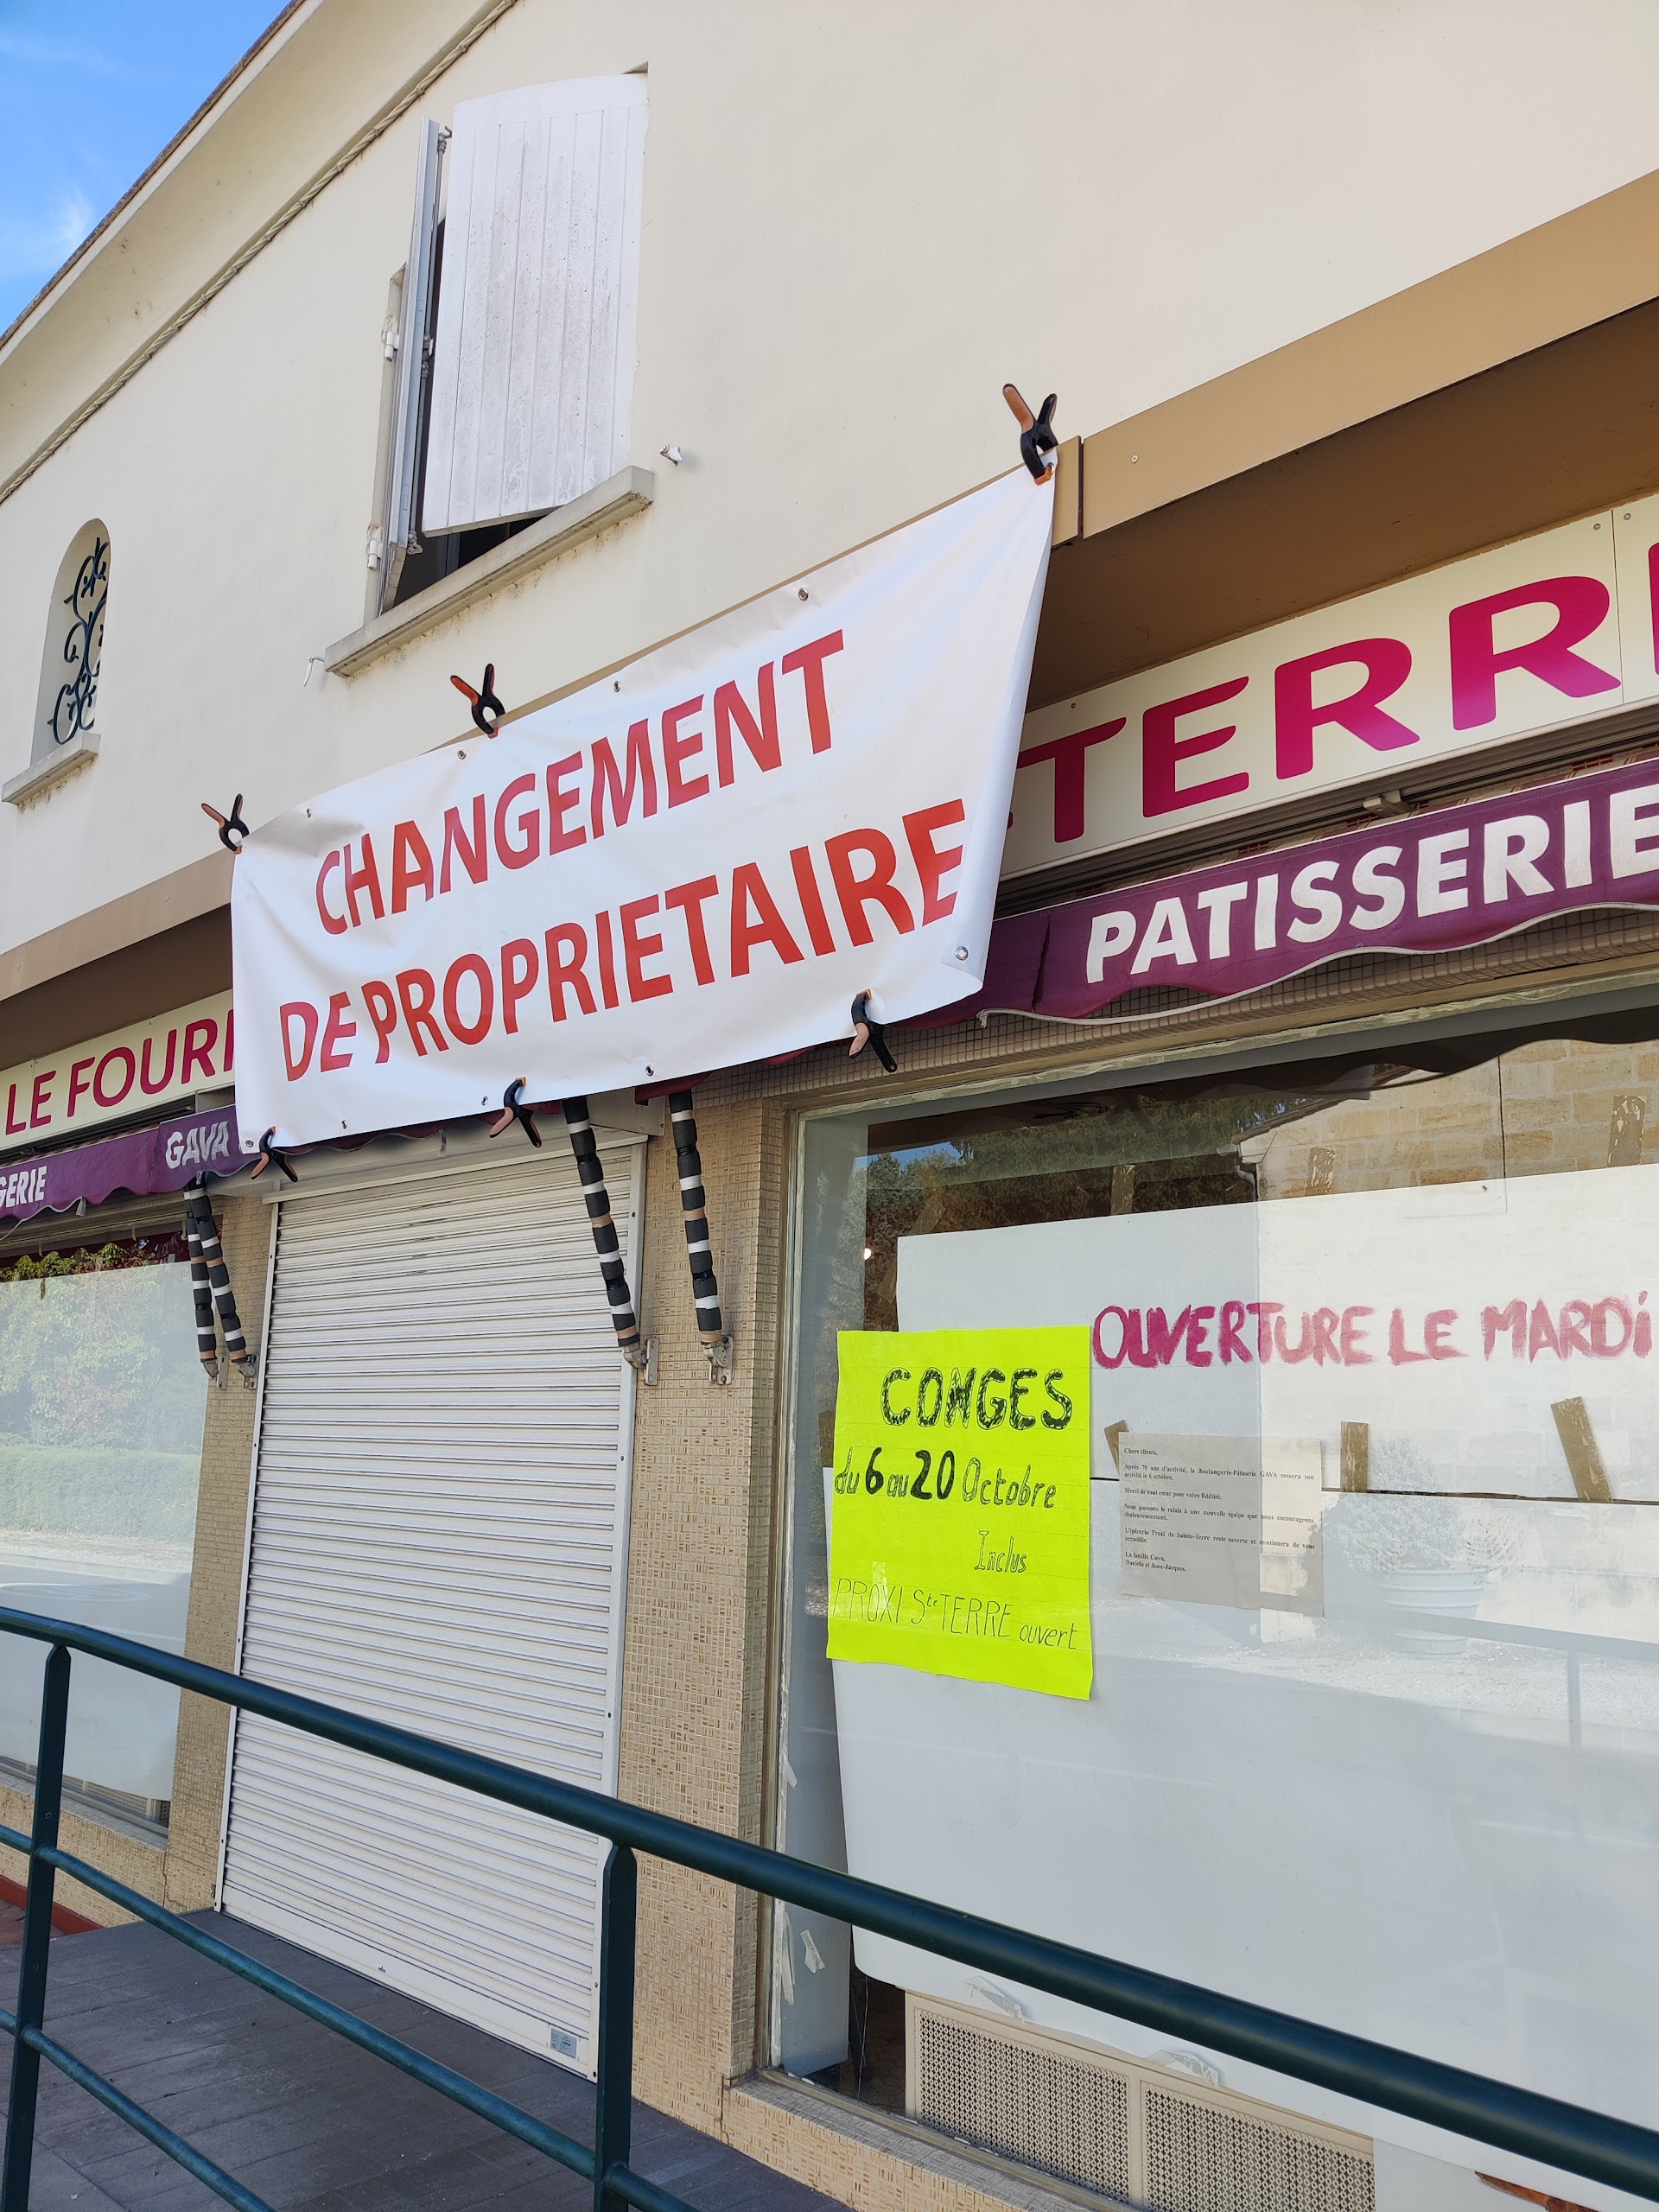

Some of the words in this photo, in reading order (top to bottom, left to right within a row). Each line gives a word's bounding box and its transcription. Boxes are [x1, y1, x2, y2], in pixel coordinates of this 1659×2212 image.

[1017, 543, 1659, 844] TERR
[315, 630, 844, 936] CHANGEMENT
[1086, 782, 1659, 984] PATISSERIE
[280, 992, 357, 1083] DE
[360, 798, 966, 1065] PROPRIETAIRE
[5, 1071, 57, 1135] LE
[165, 1121, 230, 1170] GAVA
[1092, 1300, 1377, 1370] OUVERTURE
[1388, 1307, 1468, 1368] LE
[880, 1366, 1074, 1431] CONGES
[835, 1446, 860, 1495] du
[866, 1446, 885, 1496] 6
[887, 1473, 910, 1498] au
[910, 1449, 956, 1500] 20
[962, 1457, 1057, 1509] Octobre
[974, 1530, 1027, 1573] Inclus
[832, 1578, 903, 1624] PROXI
[940, 1593, 1014, 1637] TERRE
[1019, 1622, 1078, 1649] ouvert
